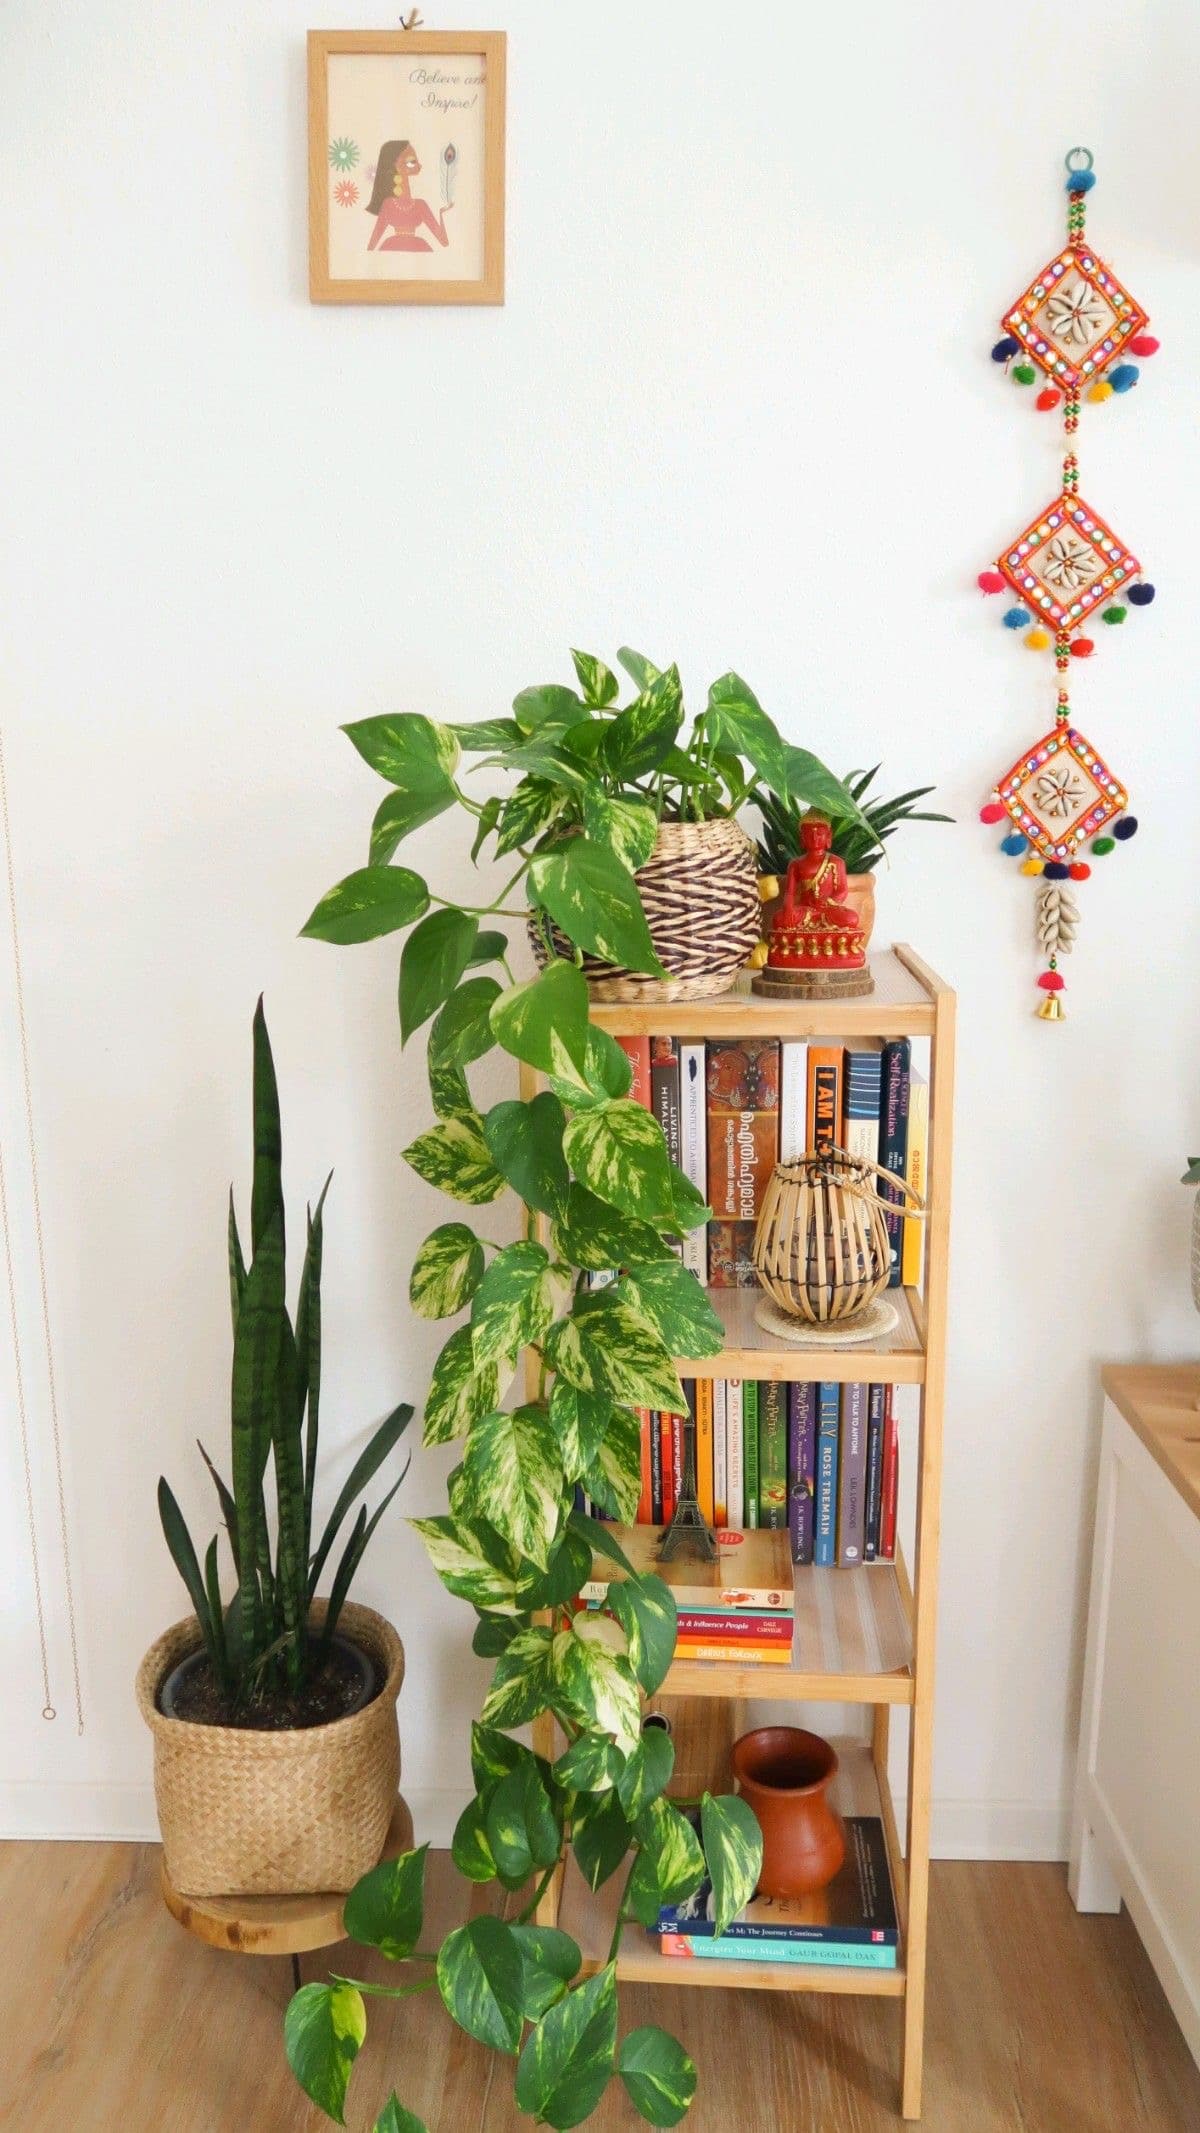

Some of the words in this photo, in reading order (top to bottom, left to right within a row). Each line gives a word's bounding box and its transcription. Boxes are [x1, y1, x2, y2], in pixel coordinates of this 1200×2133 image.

[409, 68, 460, 85] Believe
[421, 92, 478, 113] Inspire!
[817, 1072, 835, 1080] I
[817, 1085, 834, 1118] AM
[886, 1053, 903, 1137] Self-Realization
[669, 1106, 678, 1148] LIVING
[852, 1390, 860, 1400] TO
[797, 1404, 810, 1437] POTTER
[821, 1402, 838, 1438] LILY
[852, 1401, 860, 1416] TALK
[851, 1418, 859, 1426] TO
[731, 1419, 740, 1453] AMAZING
[851, 1427, 859, 1455] ANYONE
[822, 1448, 833, 1477] ROSE
[821, 1481, 833, 1536] TREMAIN
[693, 1620, 725, 1629] Influence
[725, 1621, 749, 1632] People
[761, 1929, 787, 1939] Journey
[789, 1930, 824, 1938] Continues
[735, 1945, 758, 1956] Your
[759, 1946, 785, 1956] Mind
[789, 1949, 817, 1958] GAUR
[819, 1950, 852, 1960] GOPAL
[854, 1952, 879, 1961] DAS
